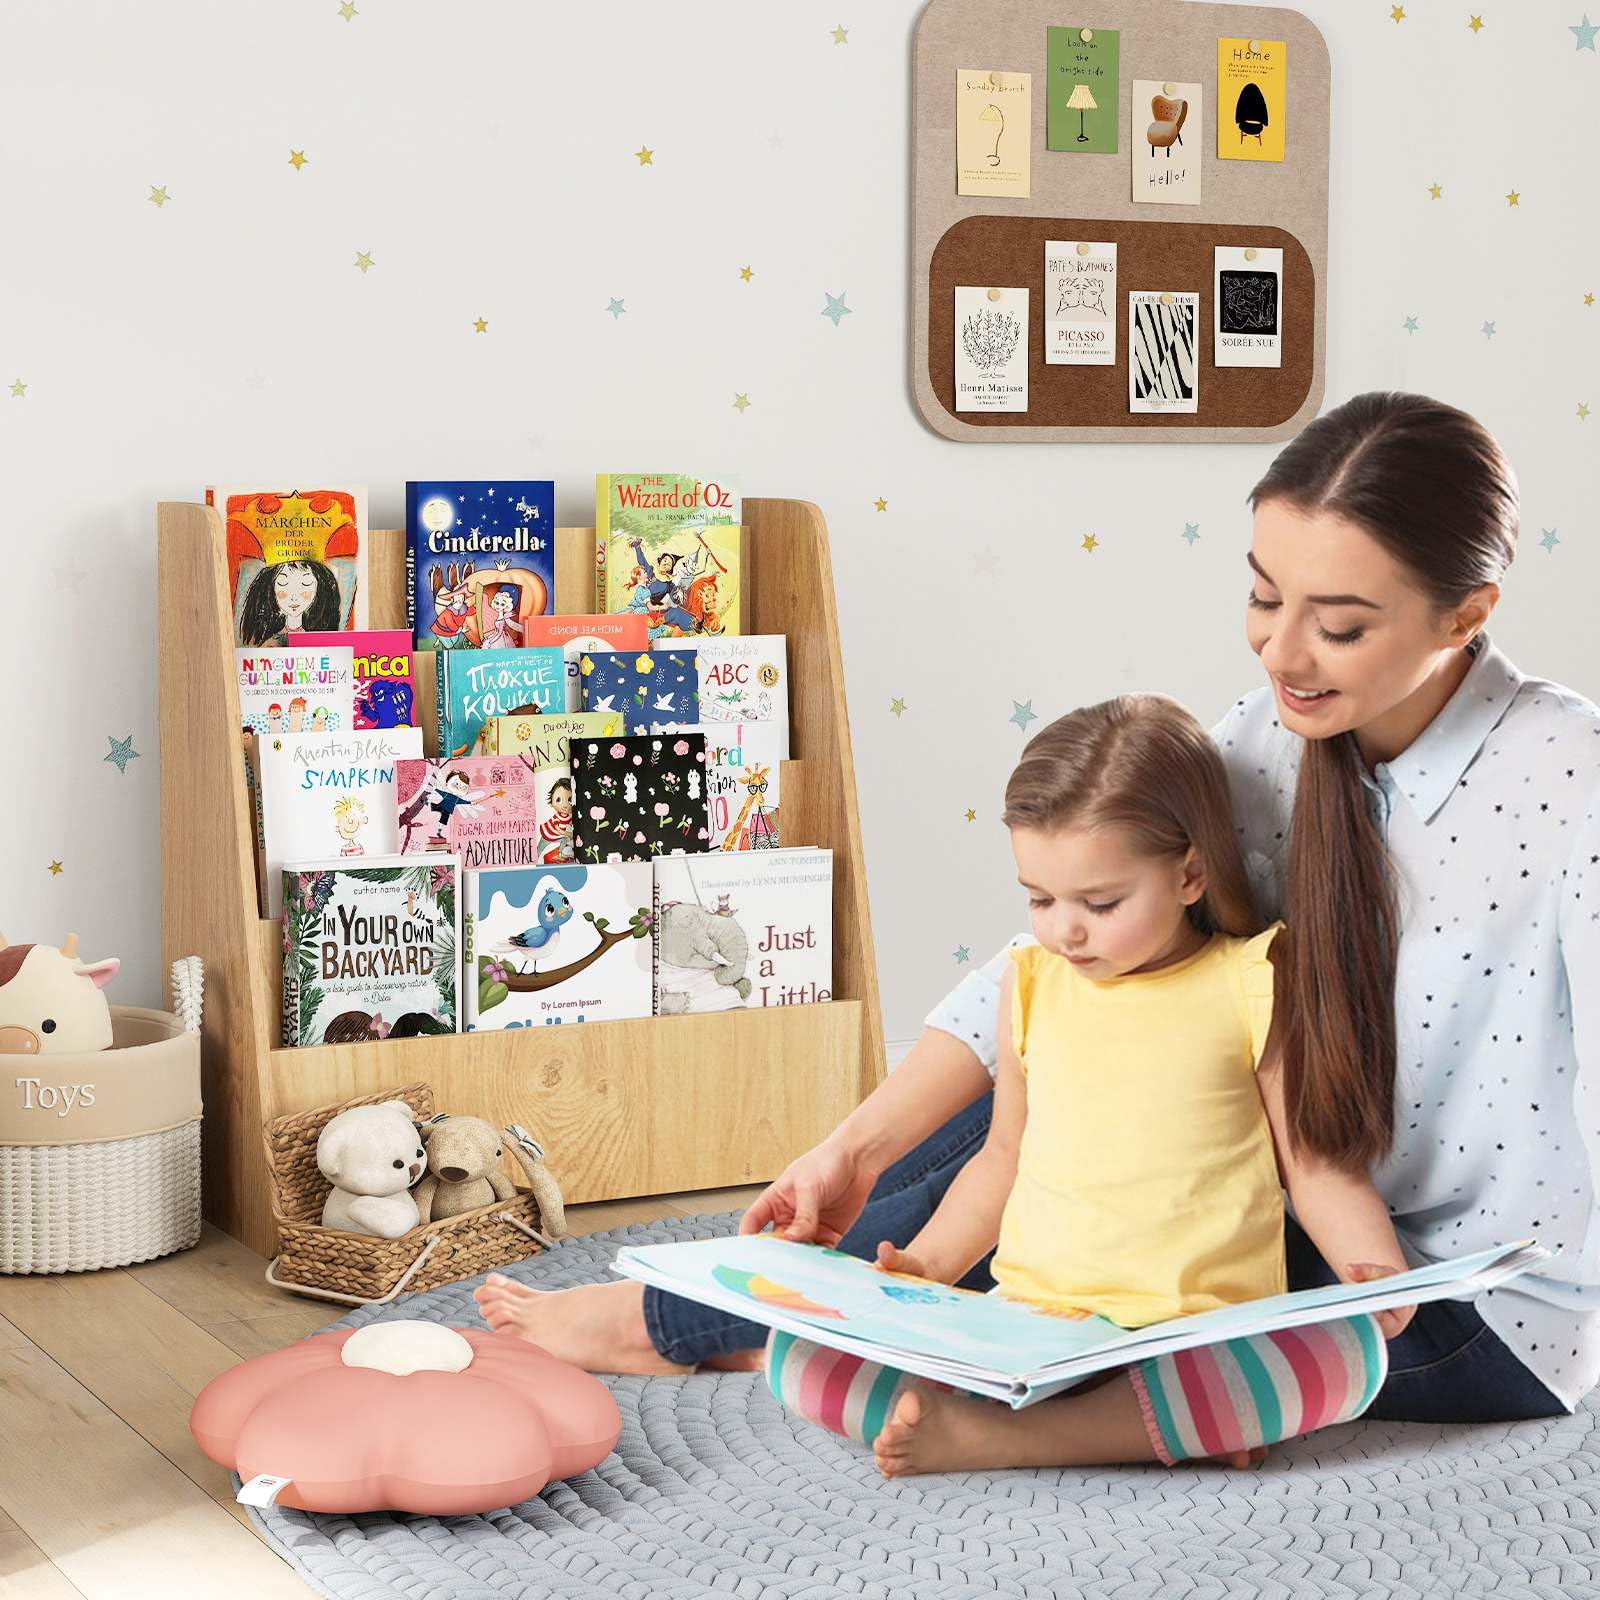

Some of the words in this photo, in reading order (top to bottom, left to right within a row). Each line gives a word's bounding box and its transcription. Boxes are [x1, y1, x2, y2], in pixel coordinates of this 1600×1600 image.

[1075, 53, 1089, 61] the
[1233, 49, 1271, 60] Home
[1149, 169, 1186, 187] Hello!
[1058, 330, 1105, 341] PICASSO
[1221, 336, 1253, 347] SOIRÉE
[1256, 338, 1275, 347] NUE
[960, 383, 985, 392] Henri
[988, 383, 1023, 393] Matisse
[641, 477, 666, 486] THE
[617, 483, 679, 509] Wizard
[682, 482, 702, 508] of
[703, 483, 732, 508] Oz
[428, 527, 541, 553] Cinderella
[277, 549, 313, 557] GRIMM
[597, 542, 606, 565] Oz
[597, 584, 606, 614] zard
[353, 653, 410, 678] nica
[705, 663, 749, 686] ABC
[544, 723, 555, 733] Du
[556, 720, 570, 730] och
[568, 720, 585, 734] jag
[350, 738, 402, 763] Blake
[301, 767, 394, 790] SIMPKIN
[457, 822, 485, 836] SUGAR
[486, 820, 507, 834] PLUM
[465, 837, 535, 867] ADVENTURE
[353, 886, 378, 895] author
[337, 904, 399, 947] YOUR
[402, 920, 434, 943] OWN
[464, 912, 474, 964] Book
[758, 925, 817, 952] Just
[322, 942, 435, 980] BACKYARD
[759, 959, 775, 977] a
[541, 1001, 551, 1010] By
[553, 1000, 578, 1009] Lorem
[578, 998, 602, 1009] Ipsum
[760, 982, 832, 1008] Little
[289, 978, 299, 1048] KYARD
[15, 1078, 96, 1118] Toys
